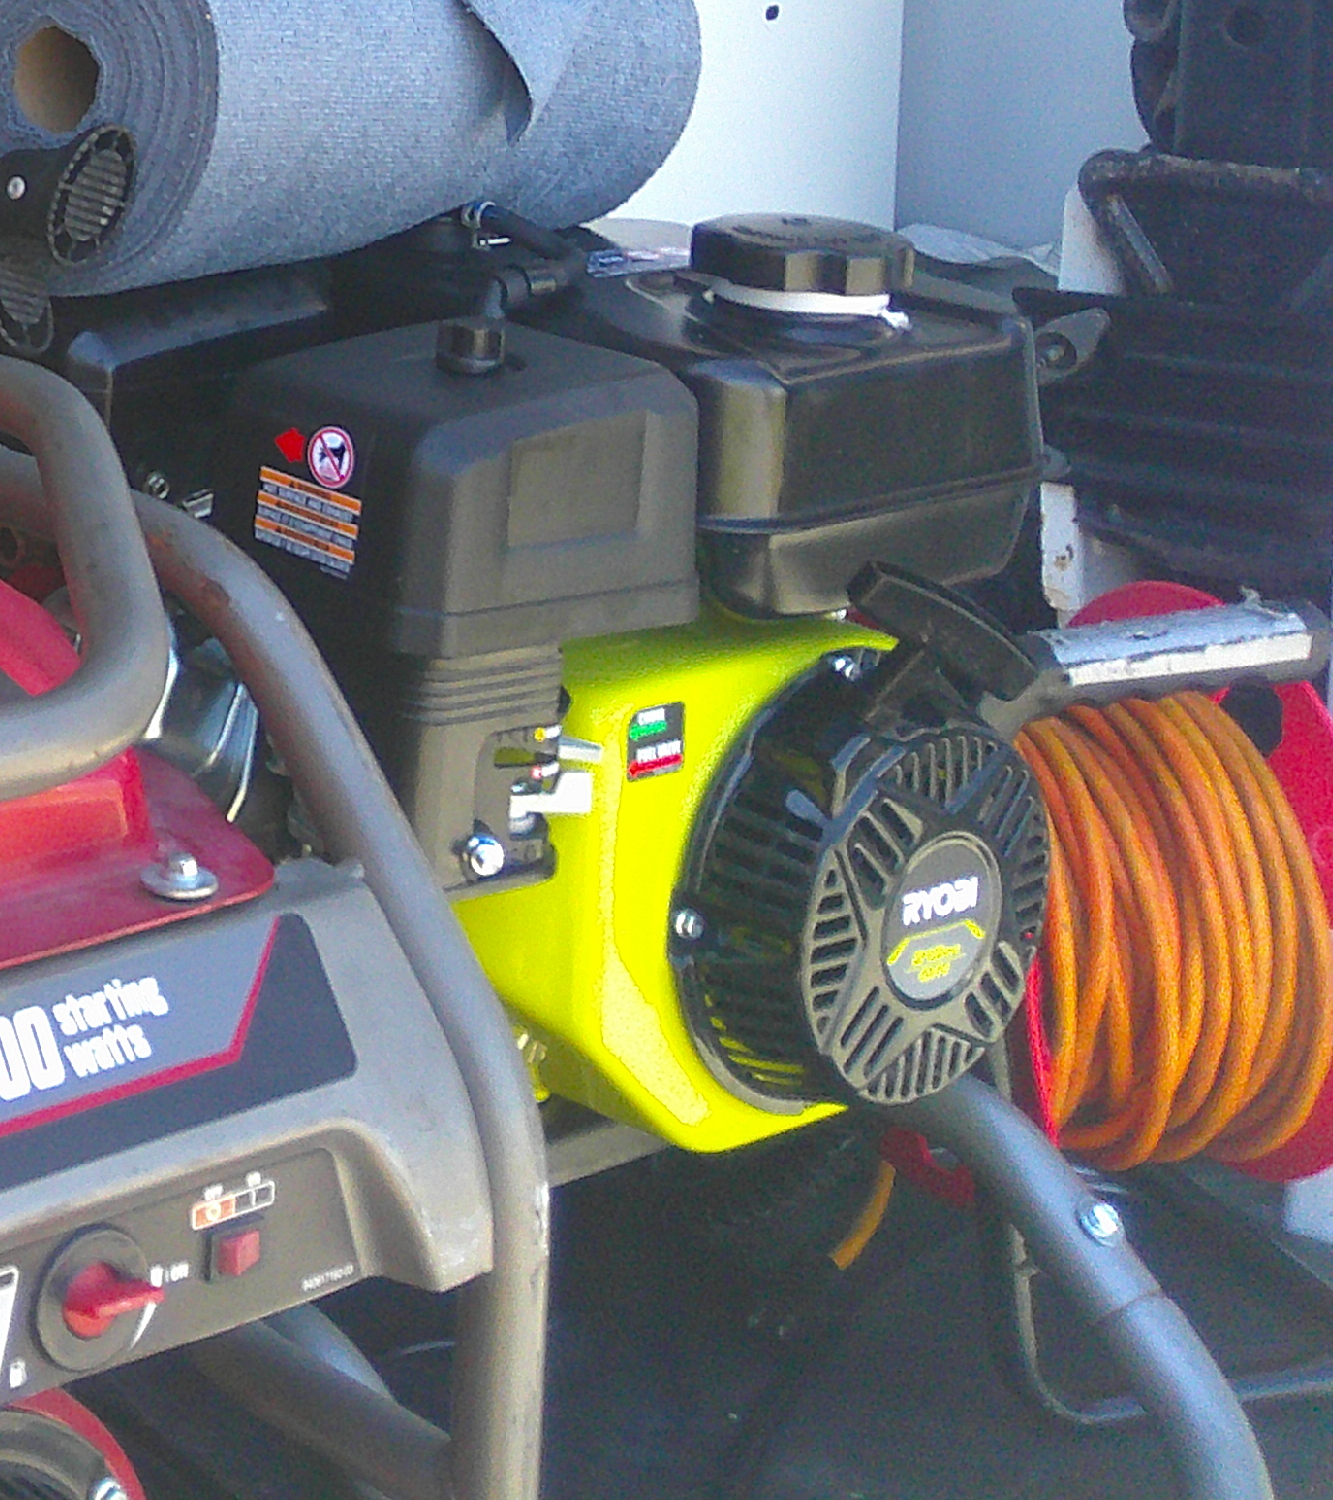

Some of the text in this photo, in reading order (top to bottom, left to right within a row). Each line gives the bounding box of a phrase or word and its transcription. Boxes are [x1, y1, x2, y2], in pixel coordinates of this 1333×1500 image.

[902, 876, 979, 927] RYOBI
[51, 976, 170, 1037] starting
[62, 1023, 153, 1079] watts
